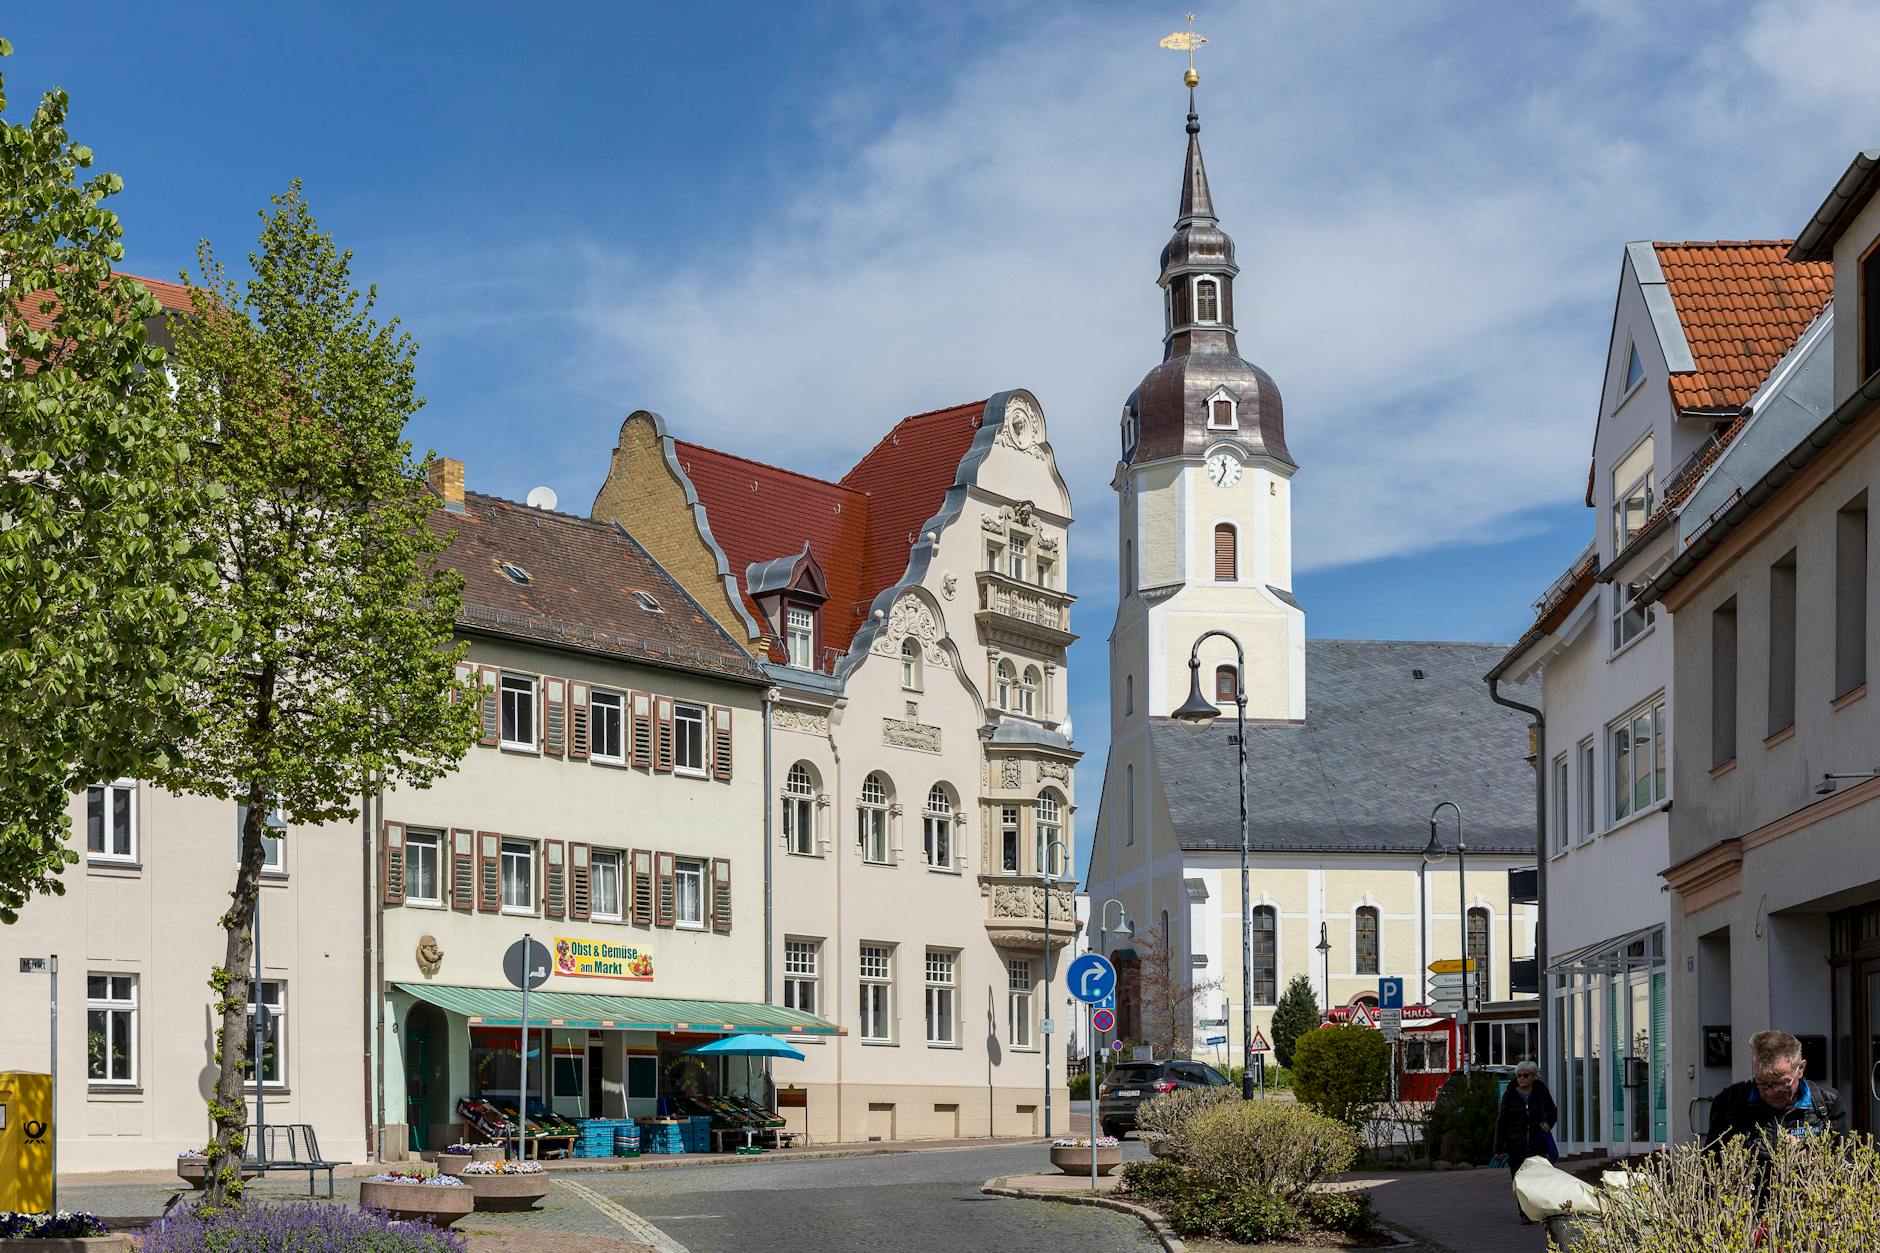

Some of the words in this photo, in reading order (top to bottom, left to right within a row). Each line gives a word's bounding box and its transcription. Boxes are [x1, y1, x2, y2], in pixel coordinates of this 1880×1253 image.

[571, 941, 592, 957] Obst
[593, 945, 600, 957] &
[601, 943, 638, 960] Gemüse
[22, 960, 46, 970] Markt
[580, 963, 593, 973] am
[594, 960, 623, 975] Markt
[1383, 981, 1397, 1005] P
[1403, 1009, 1432, 1018] HAUS
